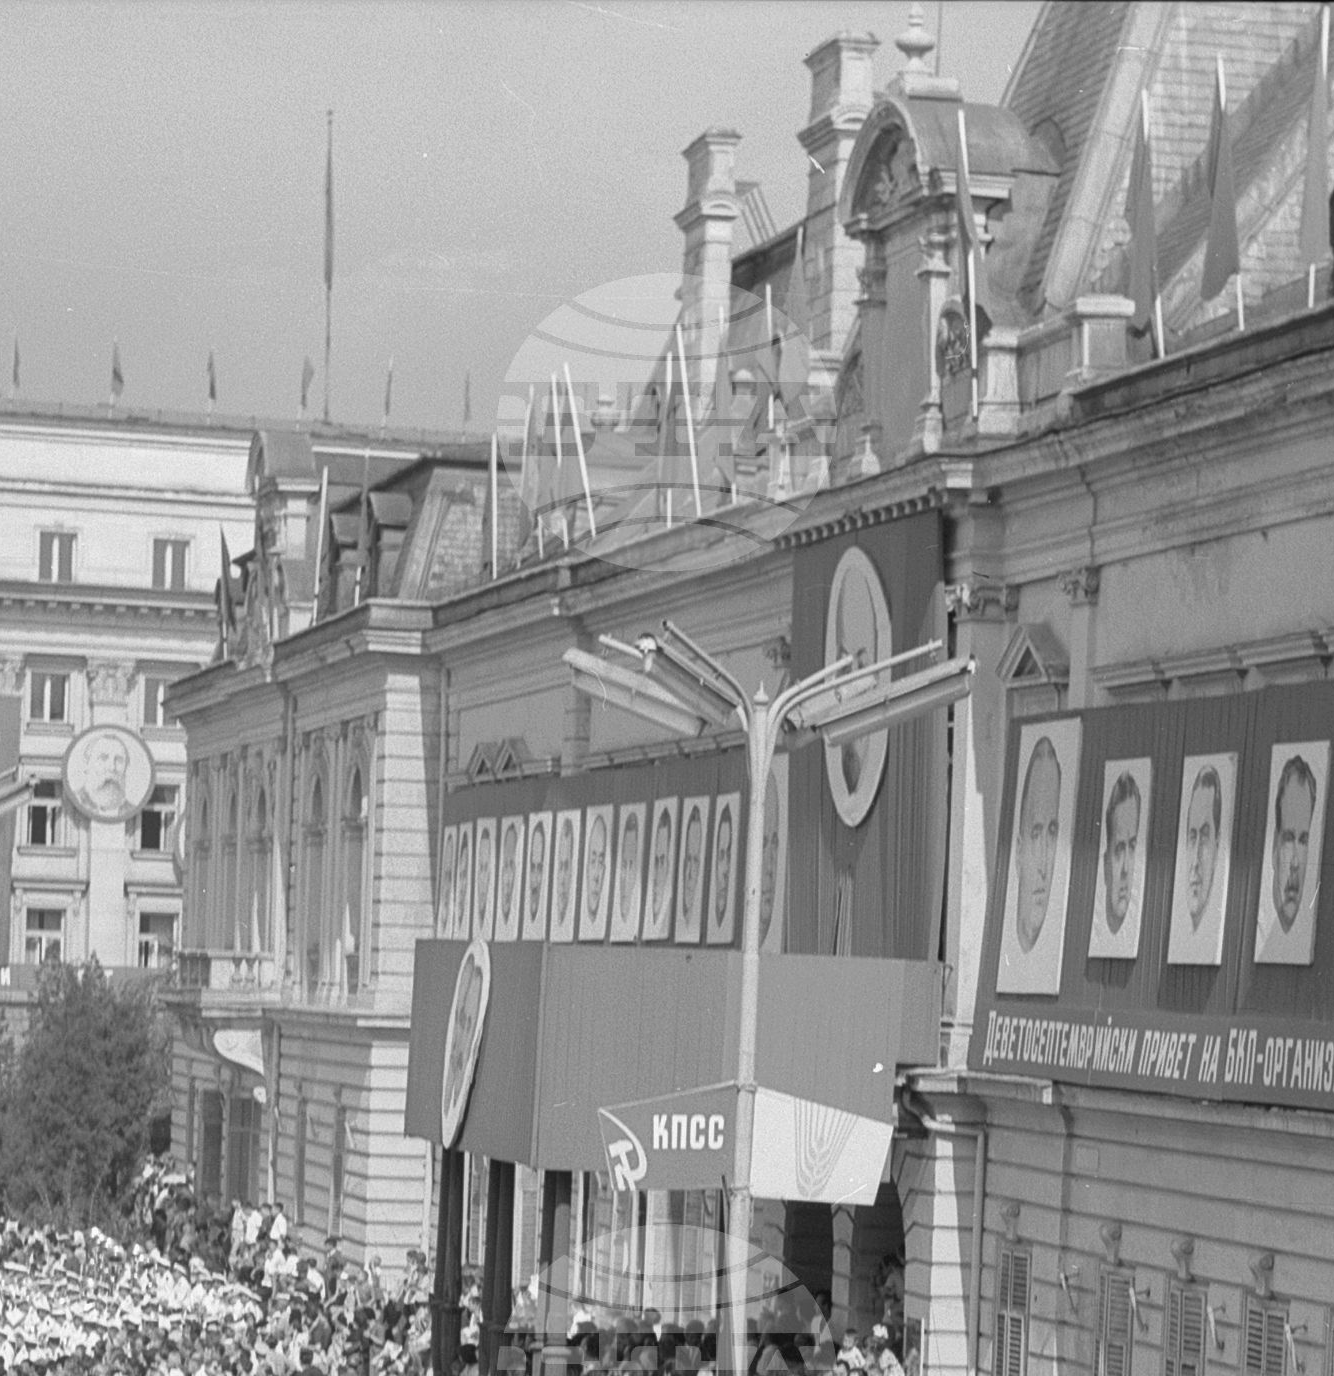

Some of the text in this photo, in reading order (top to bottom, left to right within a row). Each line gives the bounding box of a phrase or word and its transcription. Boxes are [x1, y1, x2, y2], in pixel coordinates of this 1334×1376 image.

[982, 1010, 1138, 1075] ДЕВЕТОСЕПТЕМВРИЙСКИ
[1137, 1029, 1197, 1081] ПРИВЕТ
[1198, 1035, 1222, 1084] НА
[652, 1114, 725, 1150] КПСС
